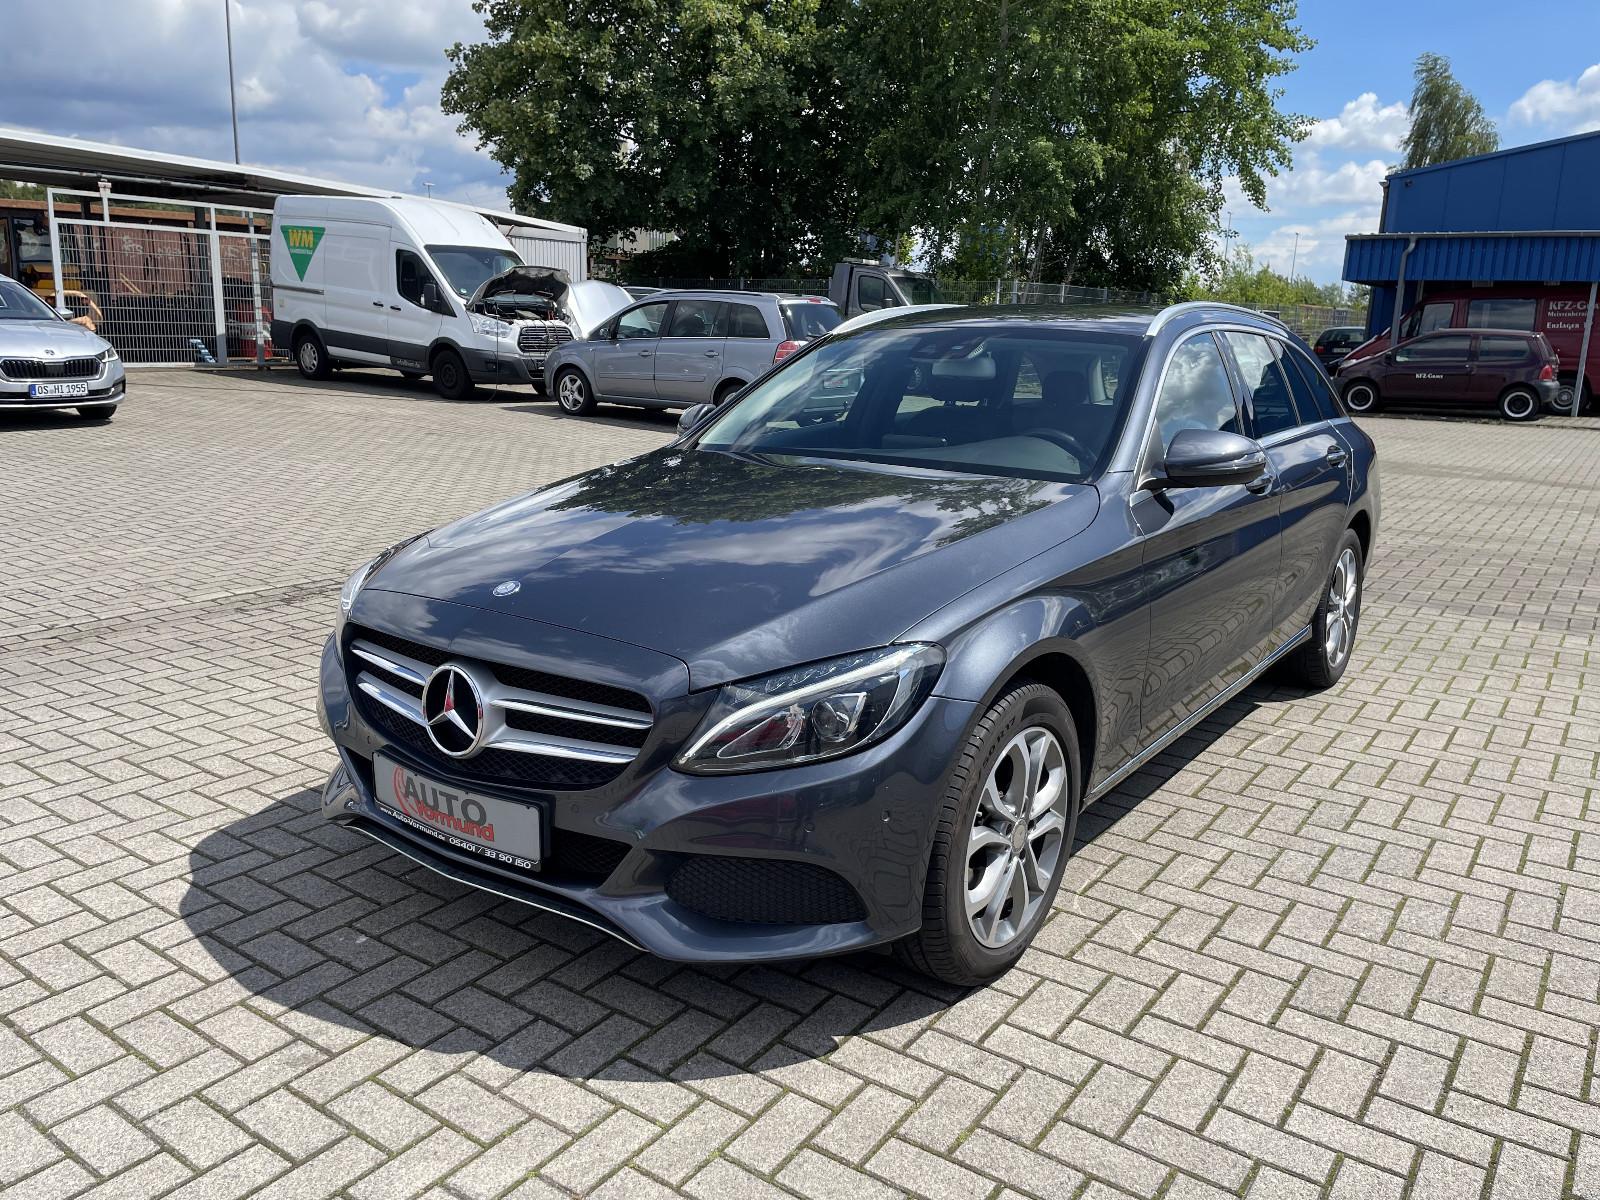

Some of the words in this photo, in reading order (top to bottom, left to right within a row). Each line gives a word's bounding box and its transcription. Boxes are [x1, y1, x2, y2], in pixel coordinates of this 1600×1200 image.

[288, 229, 314, 248] WM
[37, 385, 49, 395] OS
[53, 384, 64, 394] HI
[65, 383, 86, 394] 1955
[405, 776, 487, 827] AUTO
[414, 797, 495, 842] Vormund
[449, 837, 476, 852] 05401
[485, 849, 497, 859] 33
[499, 853, 513, 864] 90
[515, 858, 532, 869] 150
